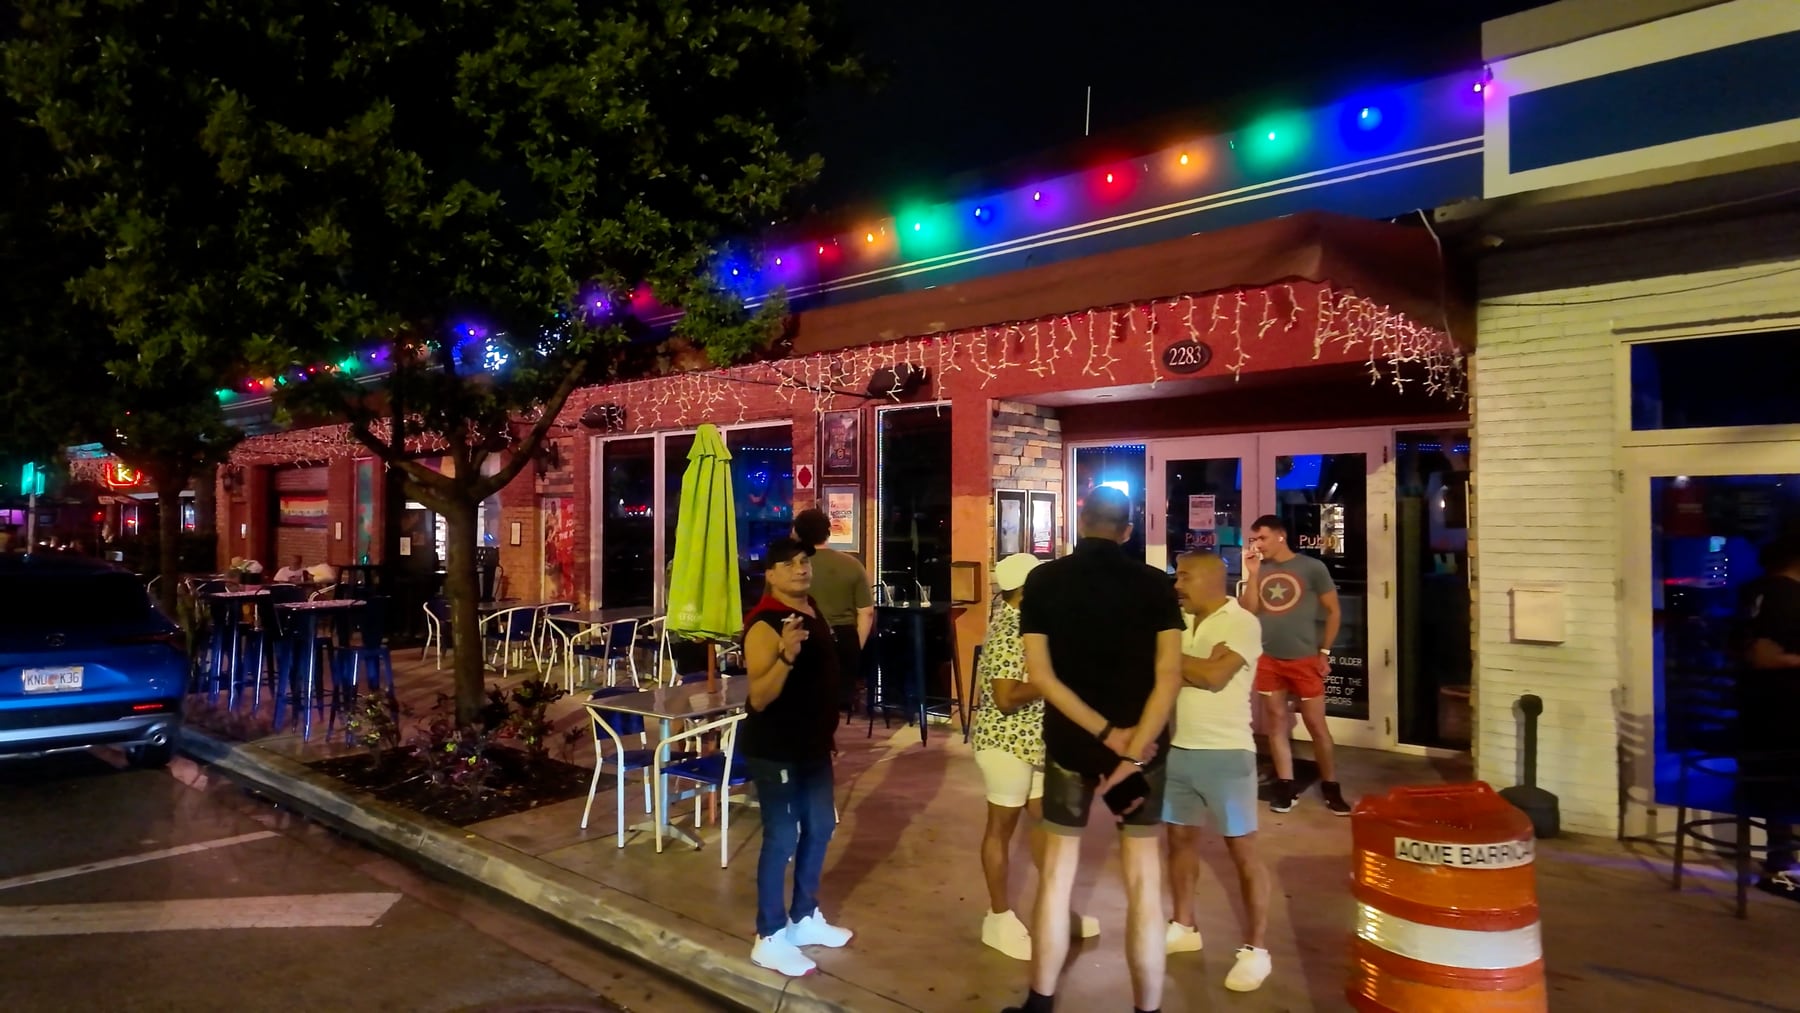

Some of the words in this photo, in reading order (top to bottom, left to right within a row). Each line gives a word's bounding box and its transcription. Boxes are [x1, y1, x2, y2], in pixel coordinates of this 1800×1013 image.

[1169, 345, 1202, 366] 2283
[1299, 533, 1326, 547] Pub
[1339, 656, 1363, 667] OLDER
[1347, 677, 1363, 687] THE
[1344, 687, 1356, 696] OF
[1399, 841, 1454, 864] ACME
